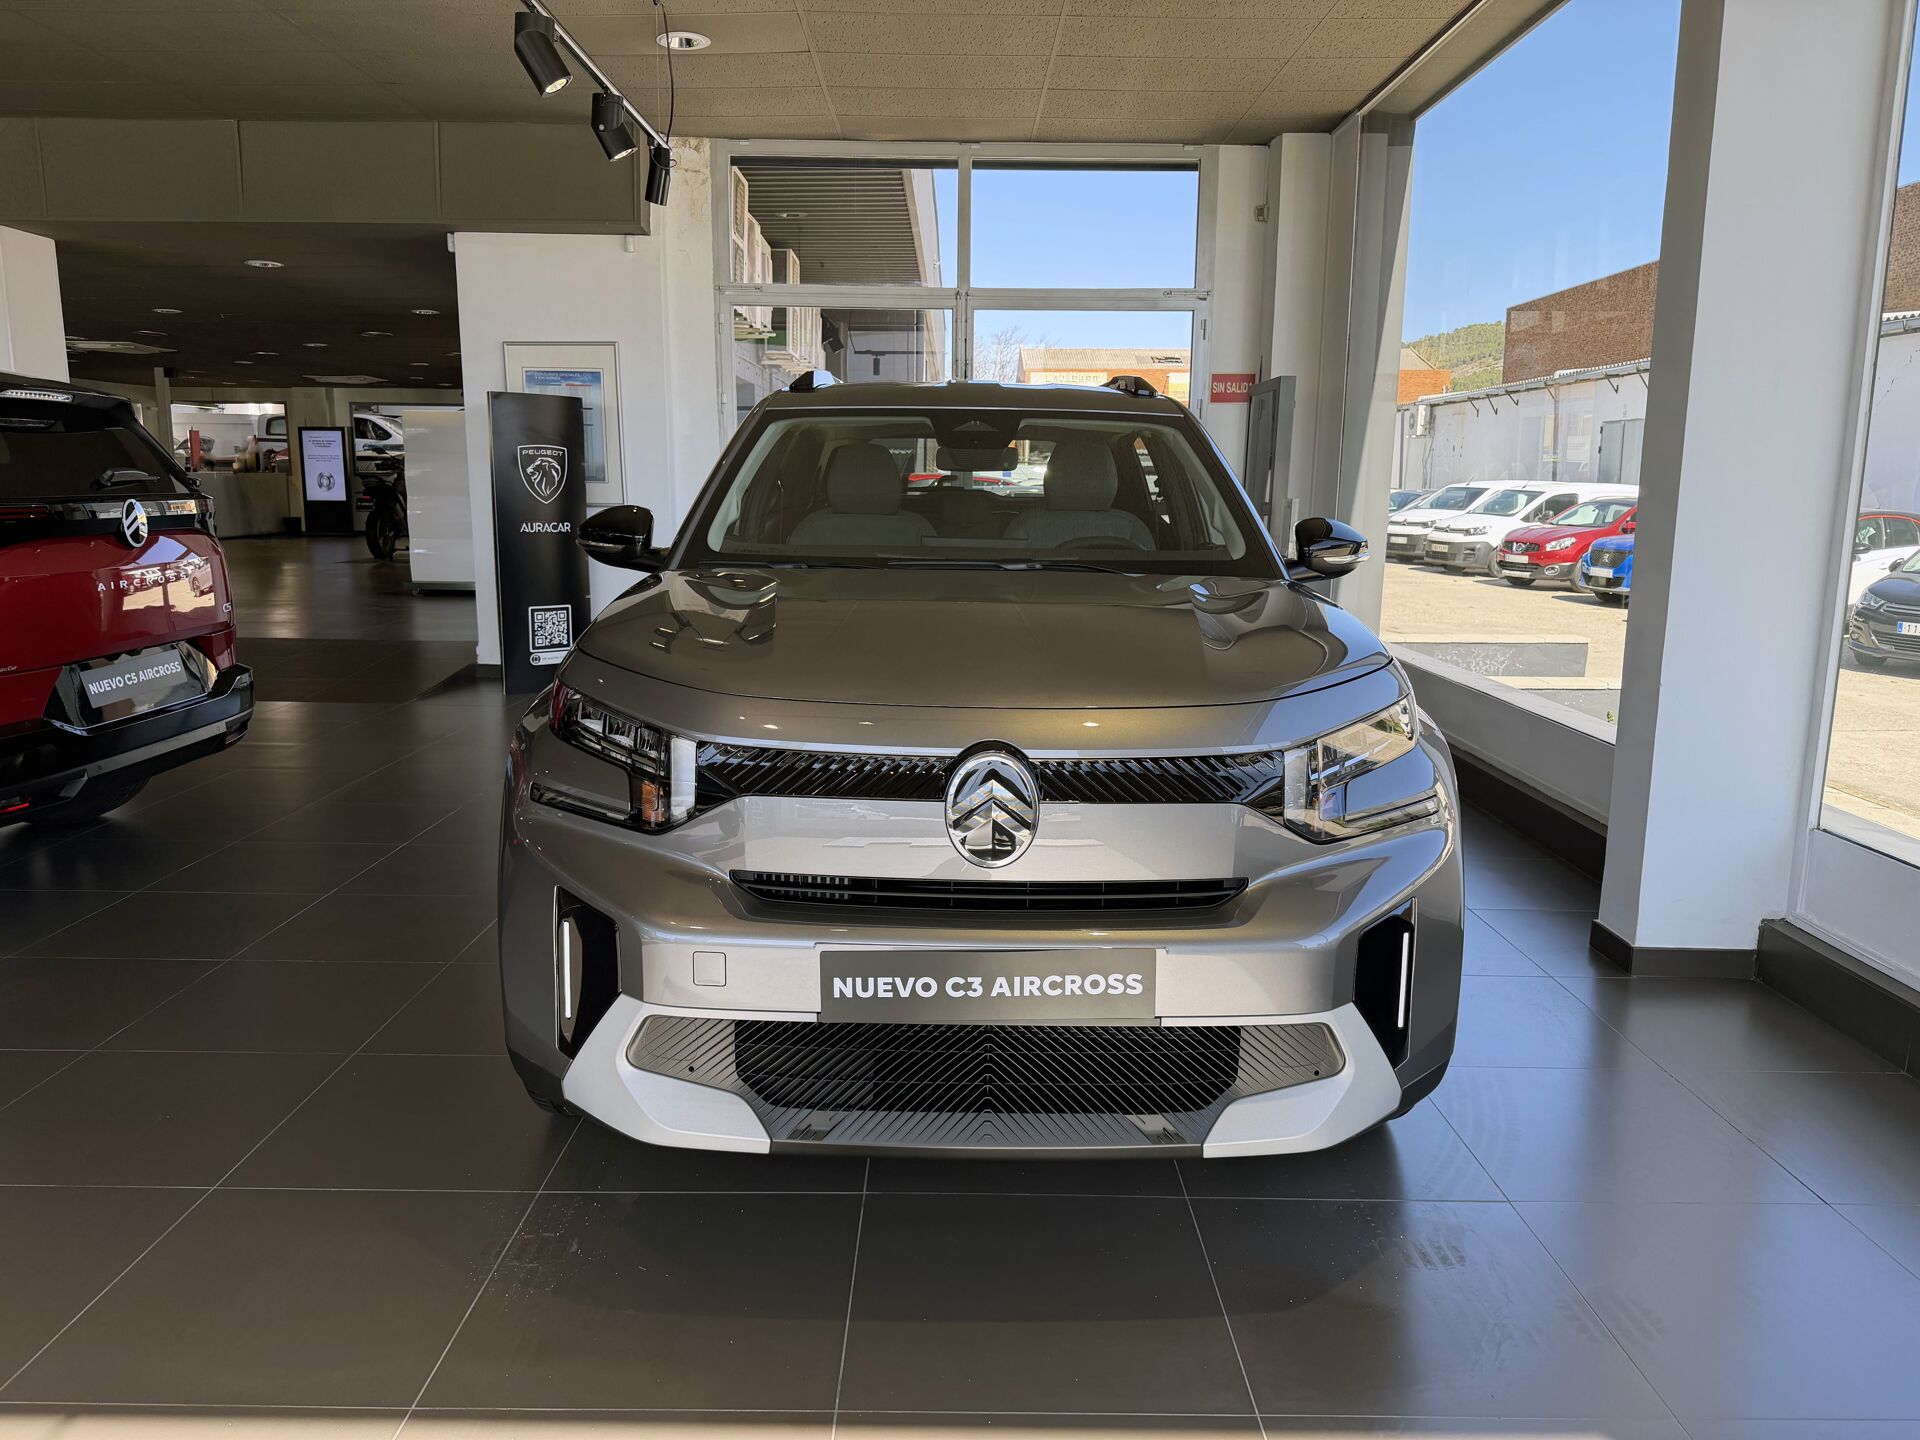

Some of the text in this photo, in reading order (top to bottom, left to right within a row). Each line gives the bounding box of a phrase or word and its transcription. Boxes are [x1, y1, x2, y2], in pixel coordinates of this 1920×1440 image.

[1212, 382, 1253, 393] SIN SALID
[522, 449, 564, 457] PEUGEOT
[520, 522, 571, 533] AURACAR
[97, 573, 190, 592] AIRCROSS
[88, 661, 181, 695] NUEVO C5 AIRCROSS
[833, 973, 1144, 998] NUEVO C3 AIRCROSS
